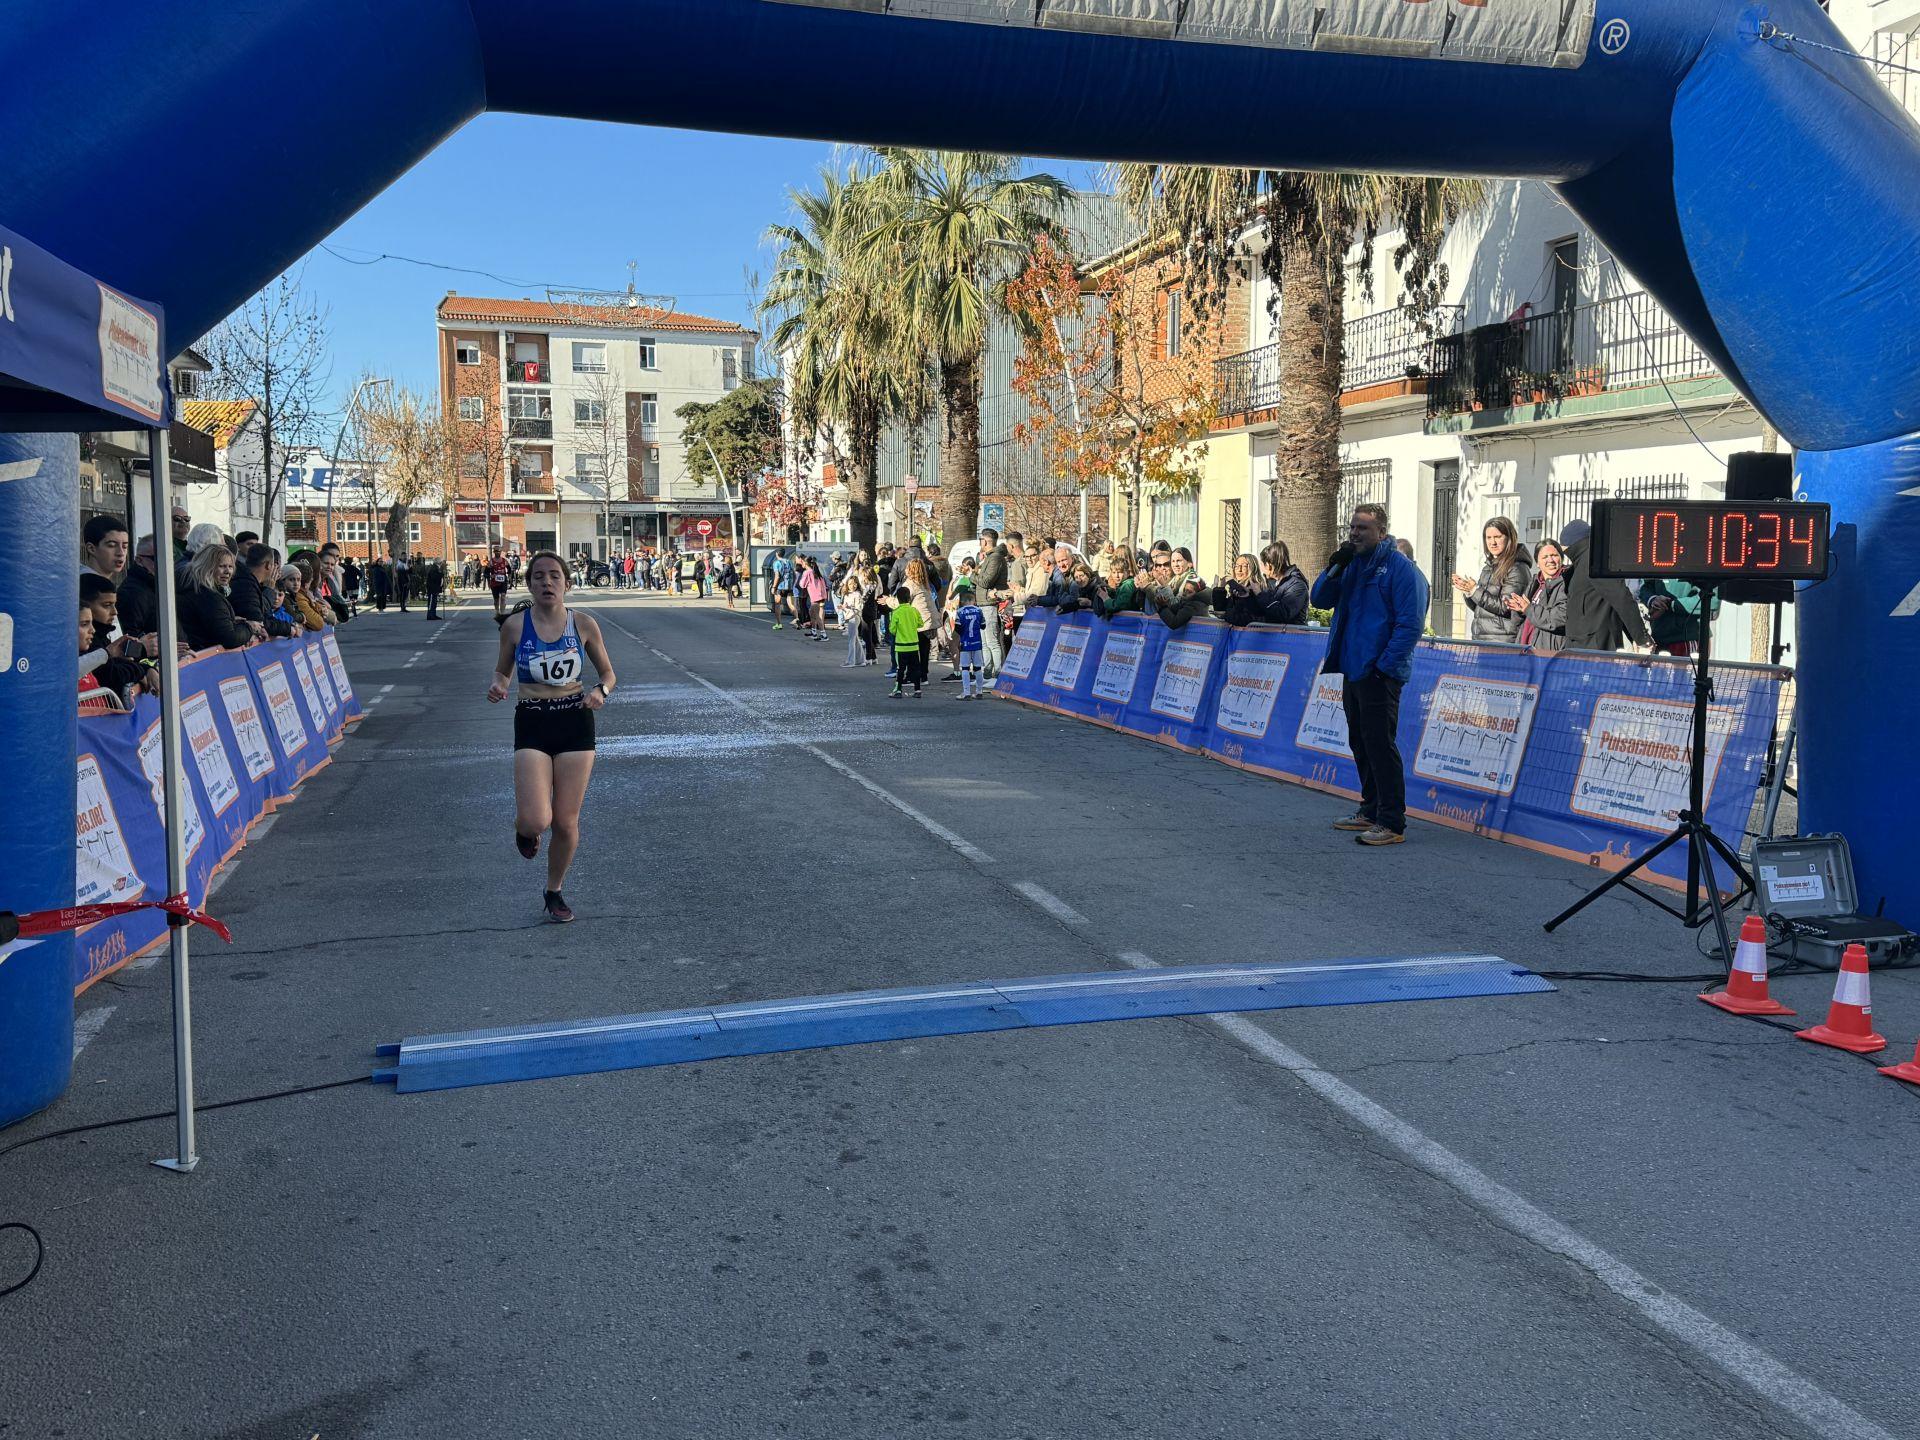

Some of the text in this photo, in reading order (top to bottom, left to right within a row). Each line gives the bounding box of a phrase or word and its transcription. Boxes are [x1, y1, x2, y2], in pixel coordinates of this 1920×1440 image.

[478, 503, 520, 513] GNERALI
[540, 659, 575, 681] 167
[1645, 708, 1654, 717] DE
[1655, 710, 1684, 722] EVENTOS
